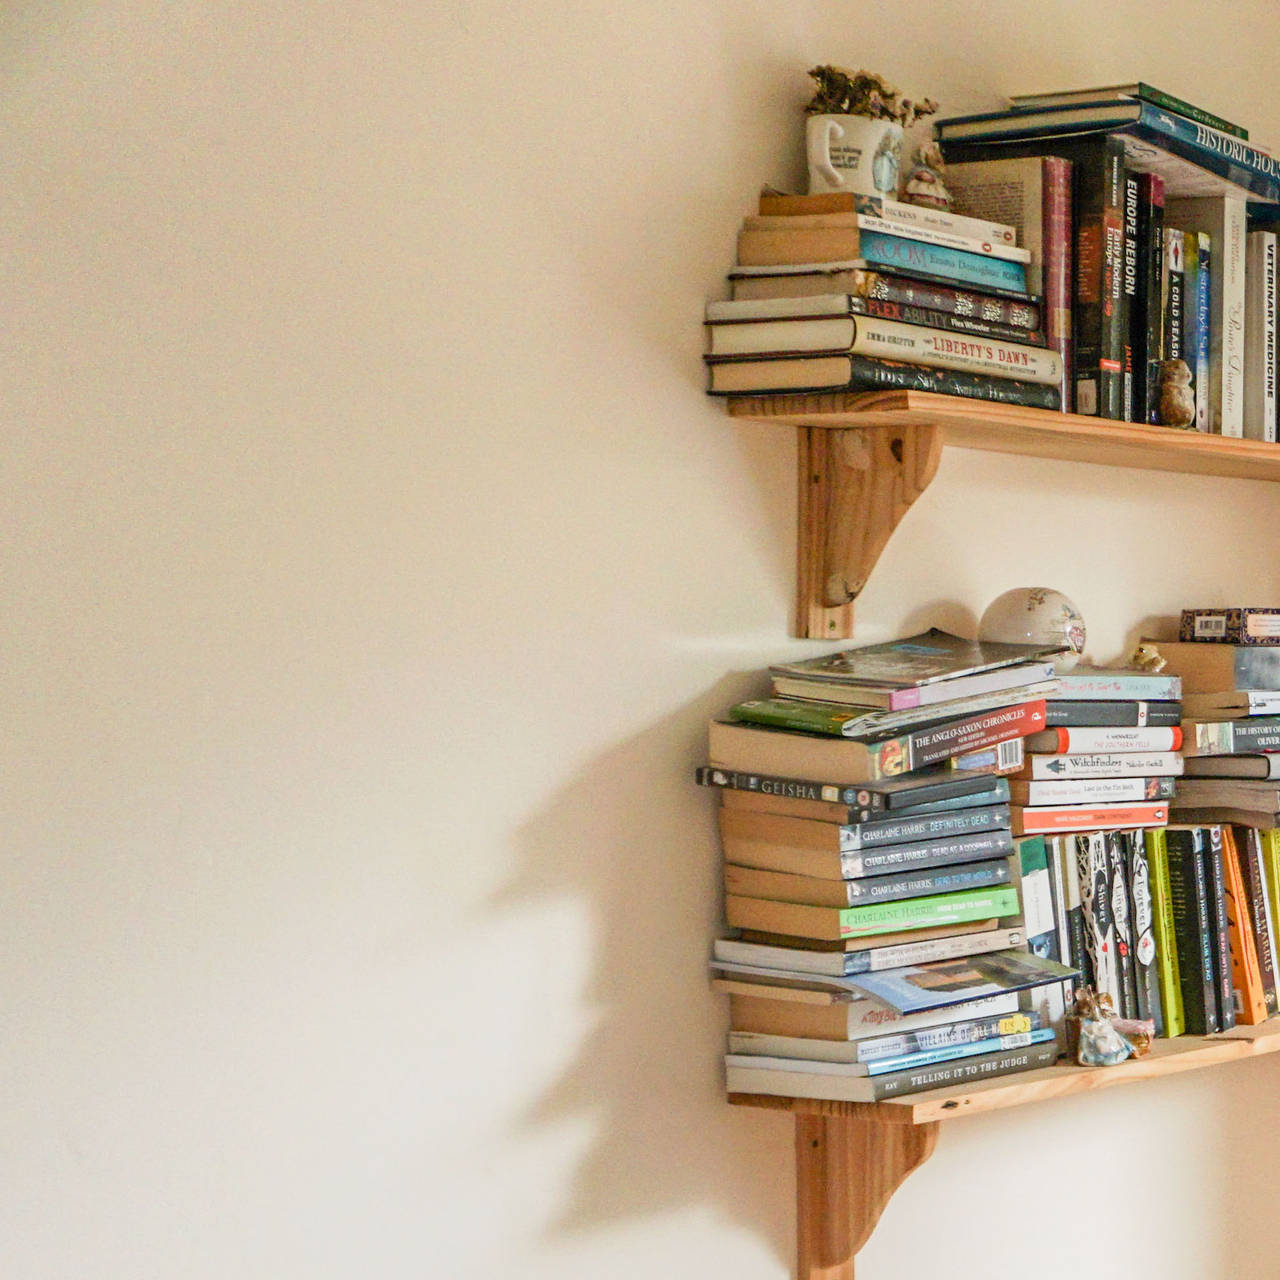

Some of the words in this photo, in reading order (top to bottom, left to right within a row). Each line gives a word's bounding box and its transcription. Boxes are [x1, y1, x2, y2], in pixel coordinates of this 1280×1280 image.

[1196, 125, 1251, 165] HISTORIC
[1126, 179, 1137, 235] EUROPE
[872, 240, 928, 267] ROOM
[1105, 226, 1114, 265] Europe
[1113, 228, 1121, 256] Early
[1112, 256, 1121, 298] Modern
[1125, 237, 1137, 295] REBORN
[1172, 275, 1179, 283] A
[1266, 244, 1274, 326] VETERINARY
[868, 300, 901, 318] FLEX
[1171, 286, 1179, 317] COLD
[932, 336, 993, 360] LIBERTY'S
[998, 348, 1029, 366] DAWN
[1171, 320, 1179, 361] SEASO
[1266, 330, 1274, 398] MEDICINE
[915, 736, 931, 750] THE
[931, 721, 983, 745] ANGLO-SAXON
[982, 708, 1025, 731] CHRONICLES
[1235, 728, 1245, 736] THE
[1247, 726, 1269, 735] HISTORY
[1271, 725, 1280, 734] OF
[1257, 735, 1279, 745] OLIVER
[1069, 755, 1122, 769] Witchfinders
[761, 779, 816, 800] GEISHA
[862, 827, 900, 841] CHARLAINE
[901, 824, 925, 835] HARRIS
[930, 818, 969, 832] DEFINITELY
[970, 815, 989, 826] DEAD
[864, 853, 902, 867] CHARLAINE
[904, 849, 928, 860] HARRIS
[871, 883, 908, 896] CHARLAINE
[909, 880, 932, 890] HARRIS
[1097, 884, 1107, 923] Shiver
[1137, 880, 1147, 926] Forever
[846, 910, 899, 925] CHARLAINE
[902, 905, 934, 917] HARRIS
[1113, 884, 1125, 925] Linger
[1259, 919, 1273, 973] HARRIS
[919, 1029, 957, 1050] VILLAINS
[960, 1028, 970, 1040] OF
[911, 1071, 951, 1086] TELLING
[953, 1068, 964, 1079] IT
[965, 1065, 977, 1076] TO
[979, 1061, 998, 1073] THE
[1000, 1055, 1028, 1069] JUDGE
